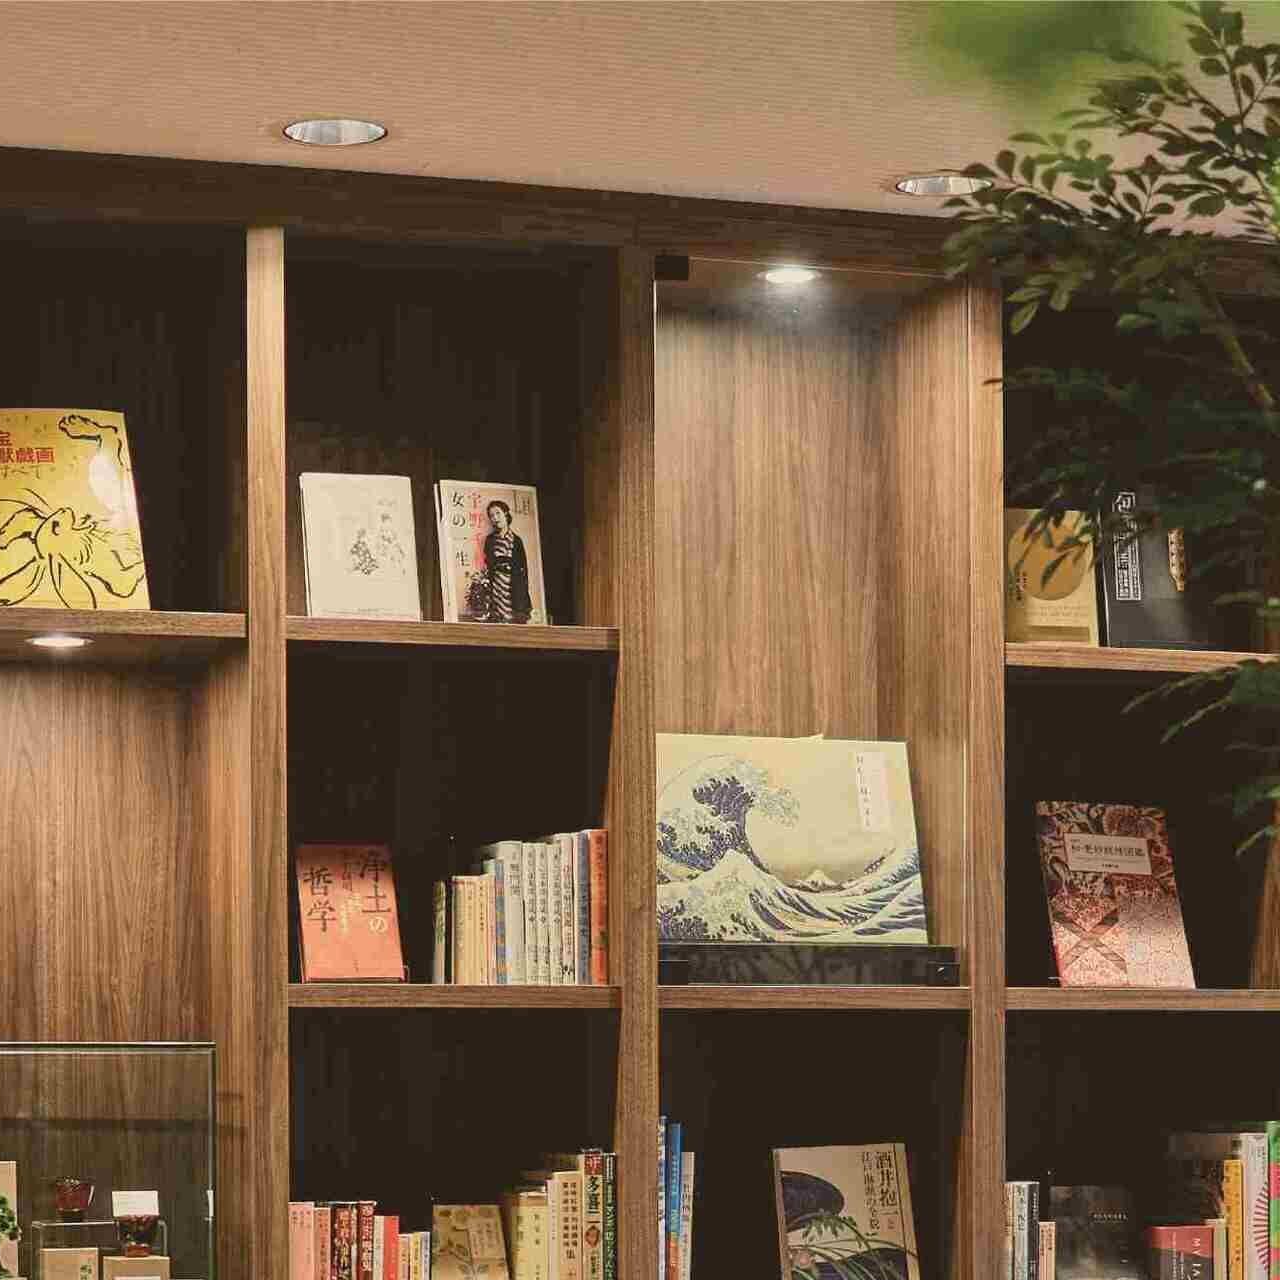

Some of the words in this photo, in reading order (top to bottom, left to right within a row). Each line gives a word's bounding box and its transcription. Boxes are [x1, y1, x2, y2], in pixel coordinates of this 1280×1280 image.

[452, 491, 469, 568] 女の一生
[304, 866, 338, 933] 哲学
